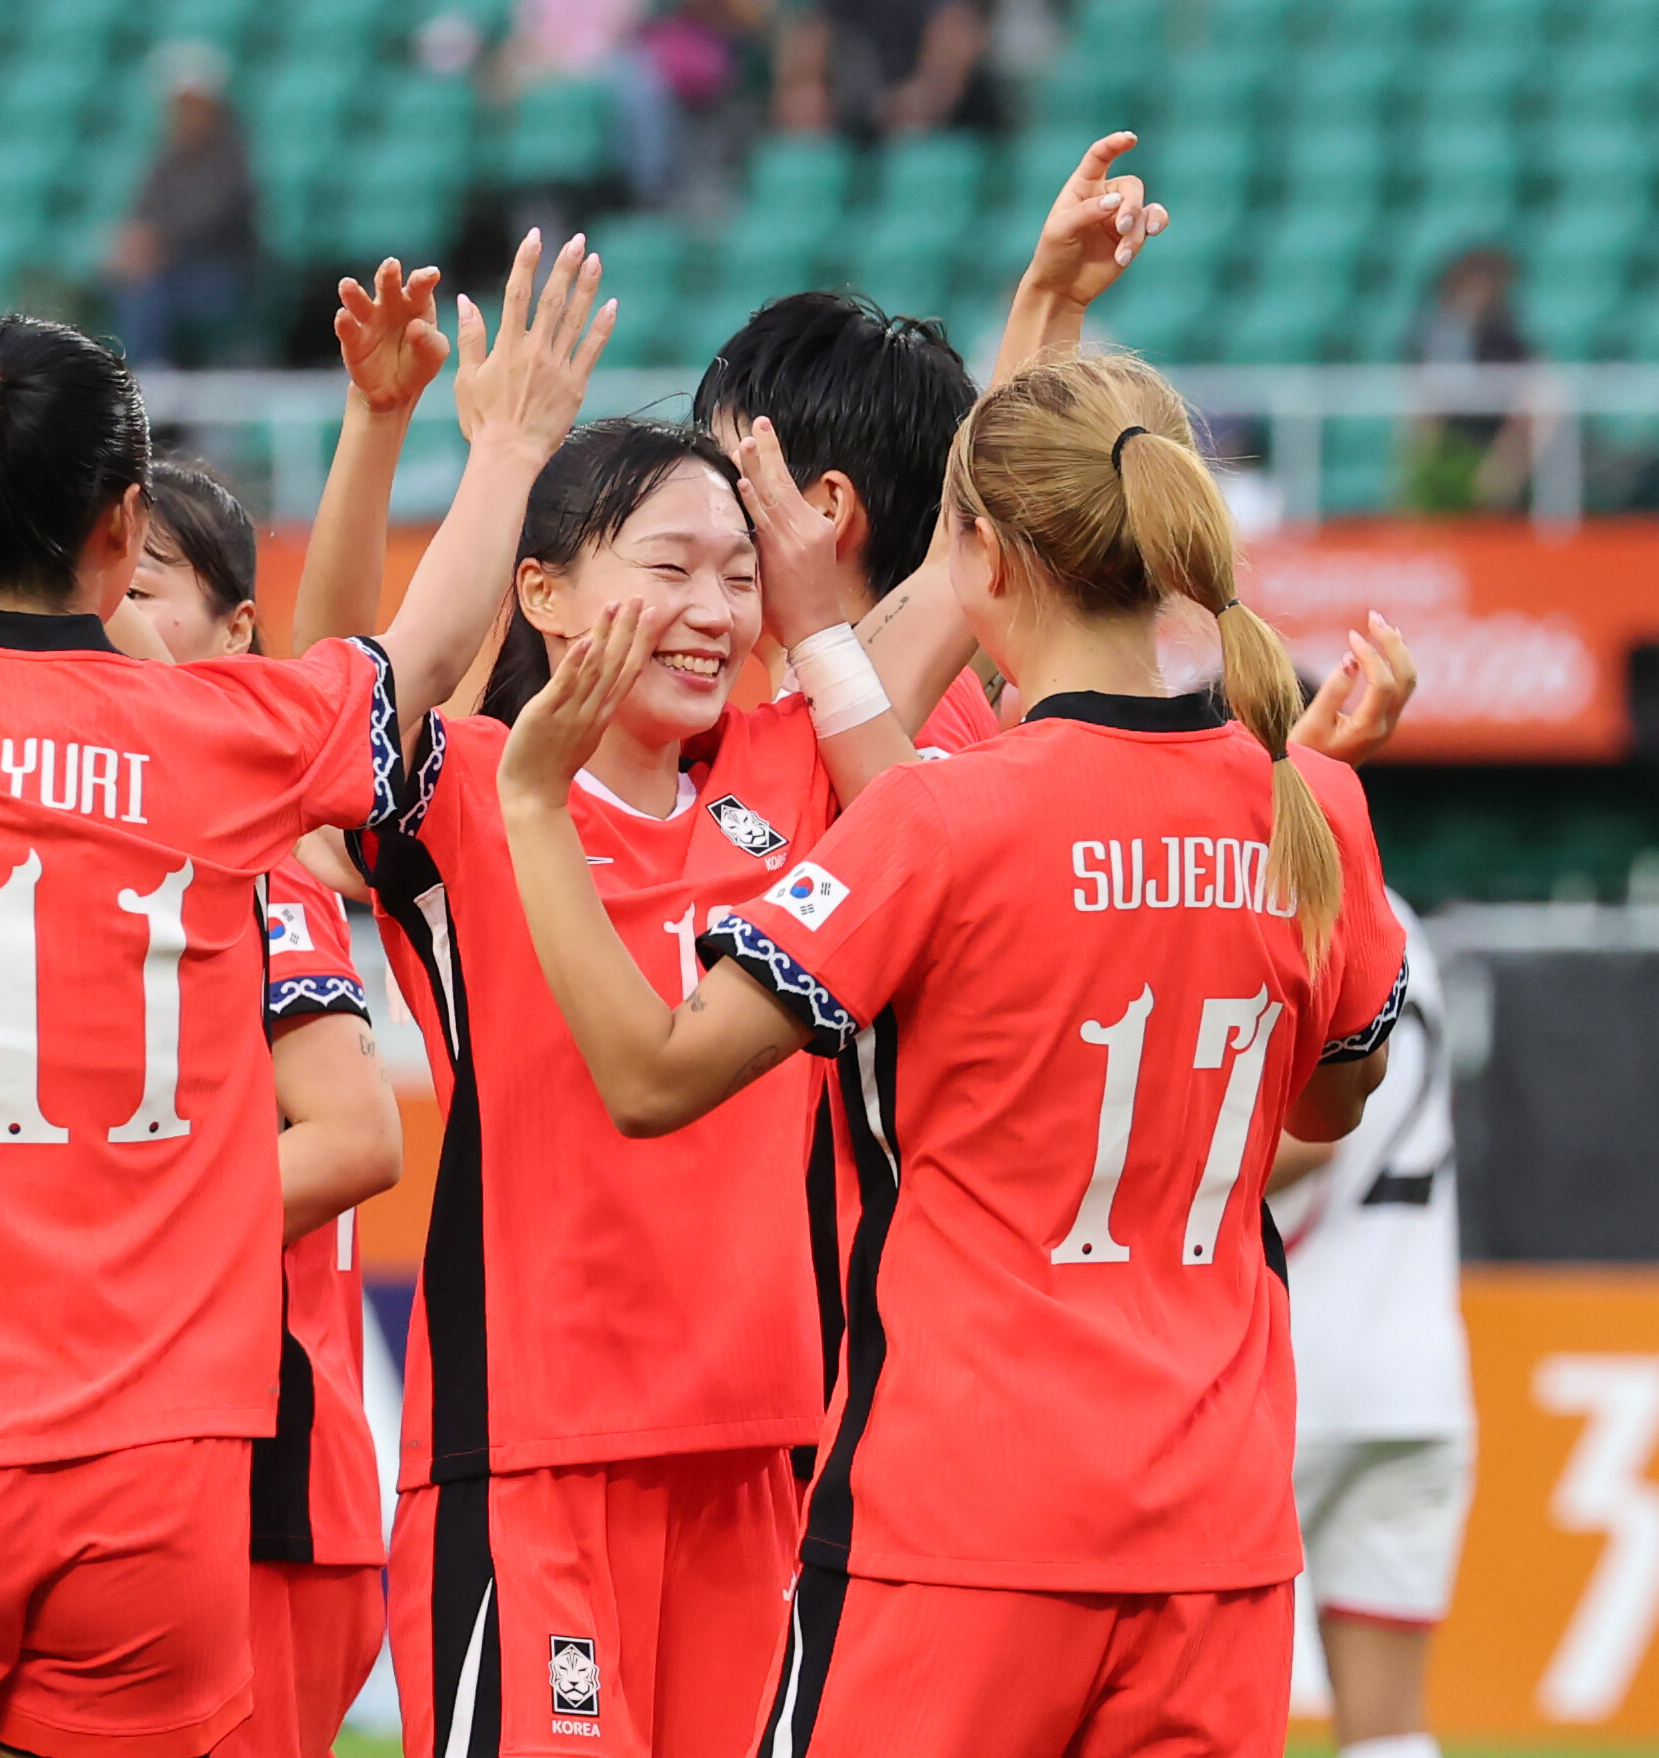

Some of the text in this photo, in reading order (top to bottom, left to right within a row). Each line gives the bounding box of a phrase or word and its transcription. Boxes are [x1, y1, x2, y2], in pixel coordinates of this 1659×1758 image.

[1, 738, 150, 824] YURI
[663, 902, 734, 1001] 1
[1050, 982, 1283, 1266] 17
[552, 1720, 601, 1738] KOREA
